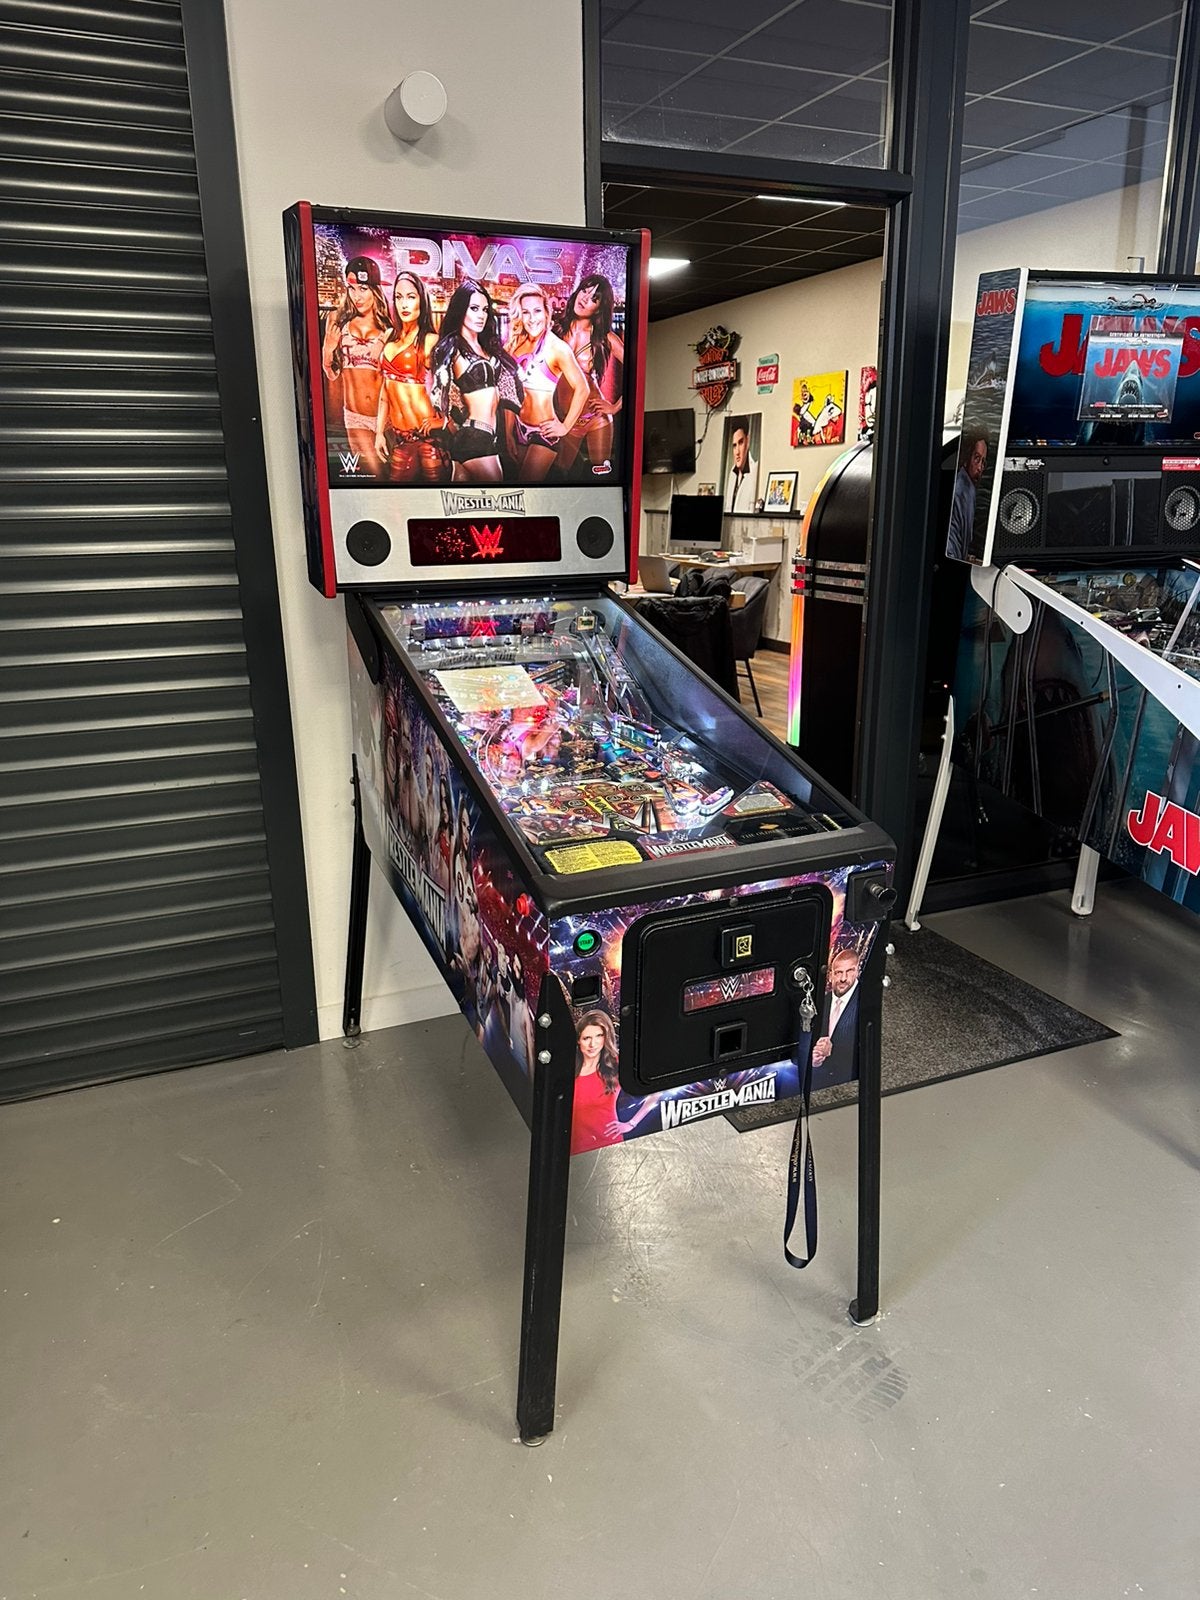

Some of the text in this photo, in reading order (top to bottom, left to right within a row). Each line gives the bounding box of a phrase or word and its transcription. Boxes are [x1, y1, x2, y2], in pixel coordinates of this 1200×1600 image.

[389, 235, 563, 285] DIVAS
[977, 287, 1017, 316] JAWS
[1094, 348, 1171, 378] JAWS
[660, 1071, 777, 1131] WRESTLEMANIA
